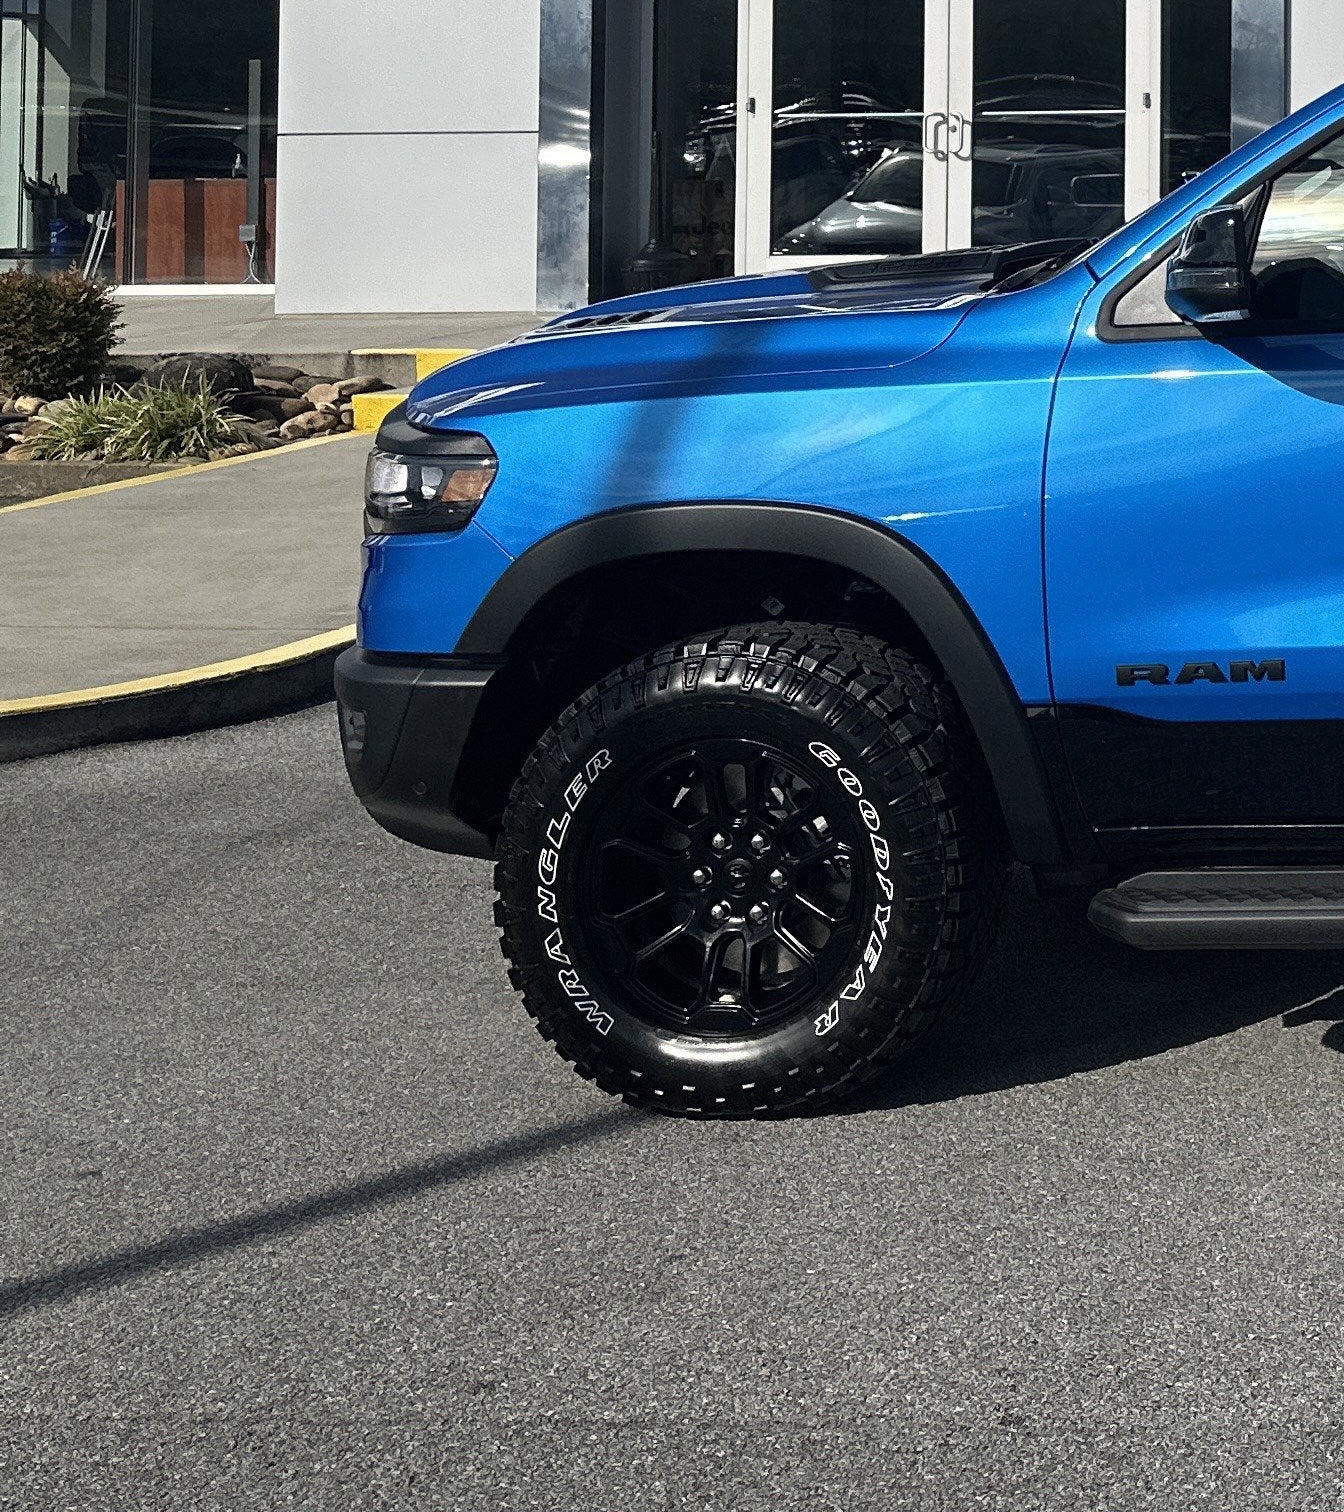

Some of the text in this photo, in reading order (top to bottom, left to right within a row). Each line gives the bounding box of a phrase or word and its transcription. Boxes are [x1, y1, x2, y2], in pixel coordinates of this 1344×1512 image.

[1115, 658, 1287, 687] RAM
[537, 748, 615, 1036] WRANGLER
[808, 740, 895, 1037] GOODYEAR
